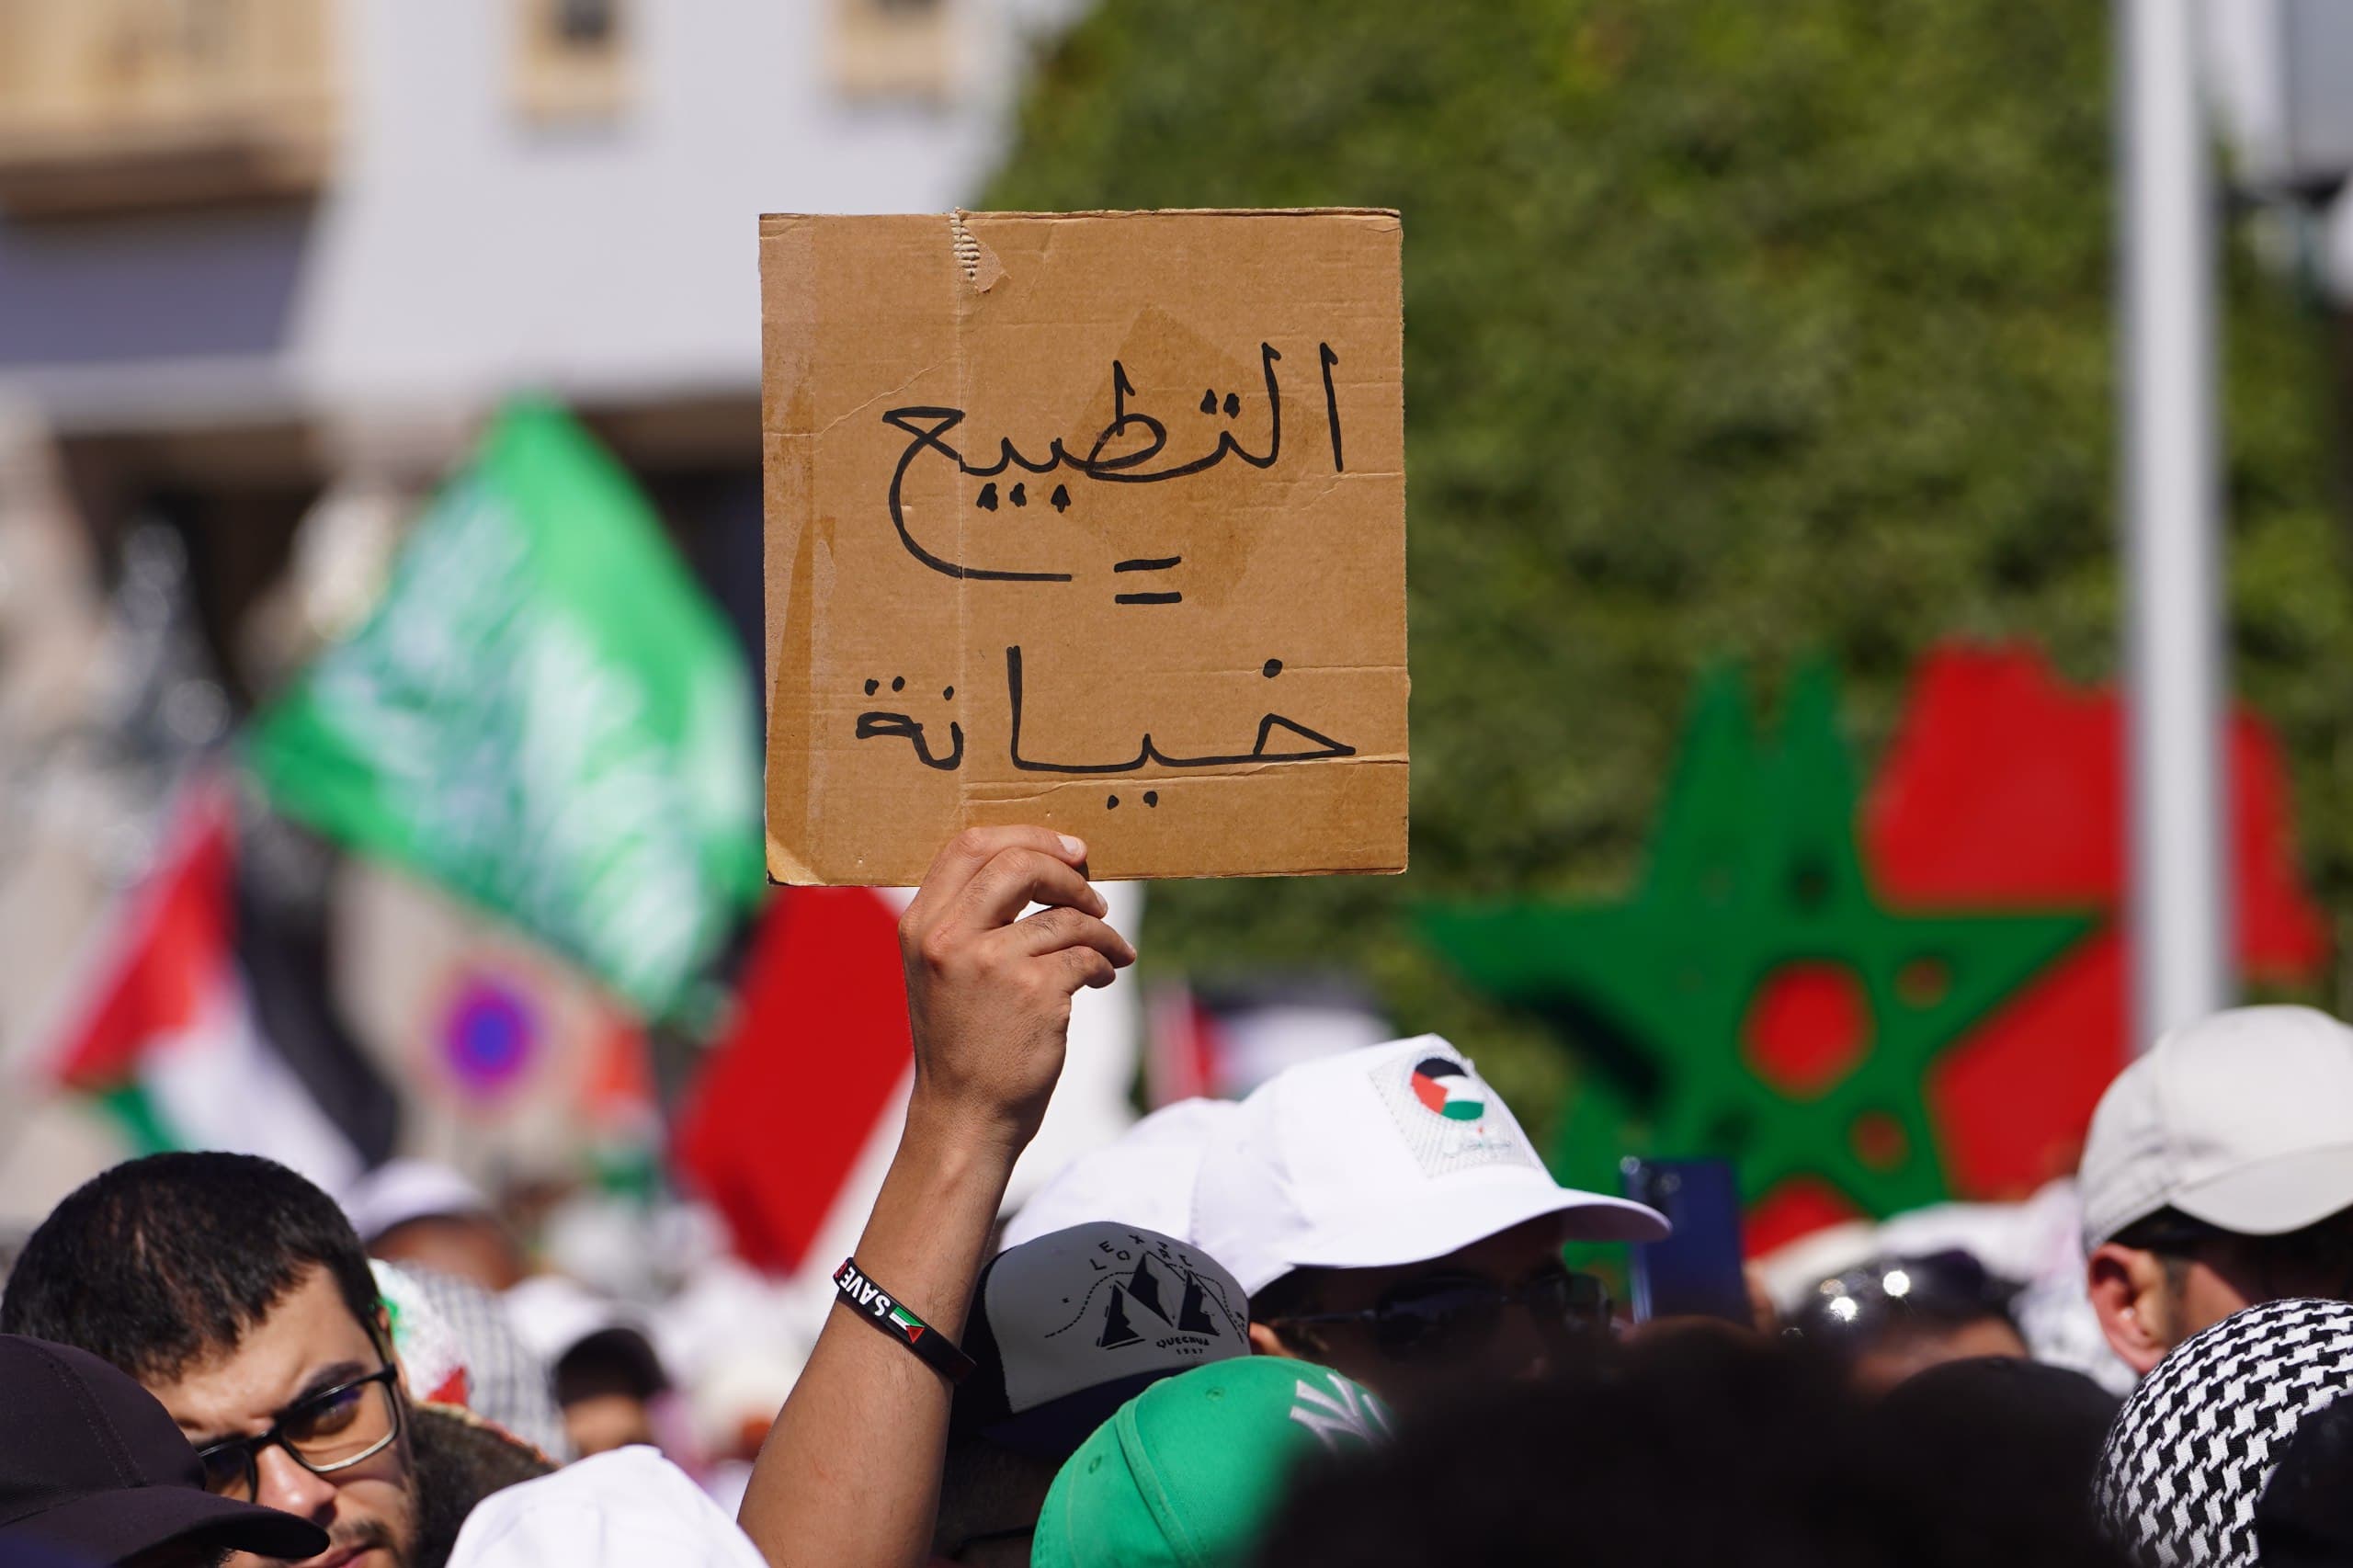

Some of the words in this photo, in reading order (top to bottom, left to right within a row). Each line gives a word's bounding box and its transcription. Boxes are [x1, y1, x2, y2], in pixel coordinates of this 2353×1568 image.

[882, 342, 1343, 582] التطبيع
[856, 646, 1356, 810] خيانة
[839, 1267, 891, 1316] SAVE
[1156, 1336, 1210, 1348] QUECHUA
